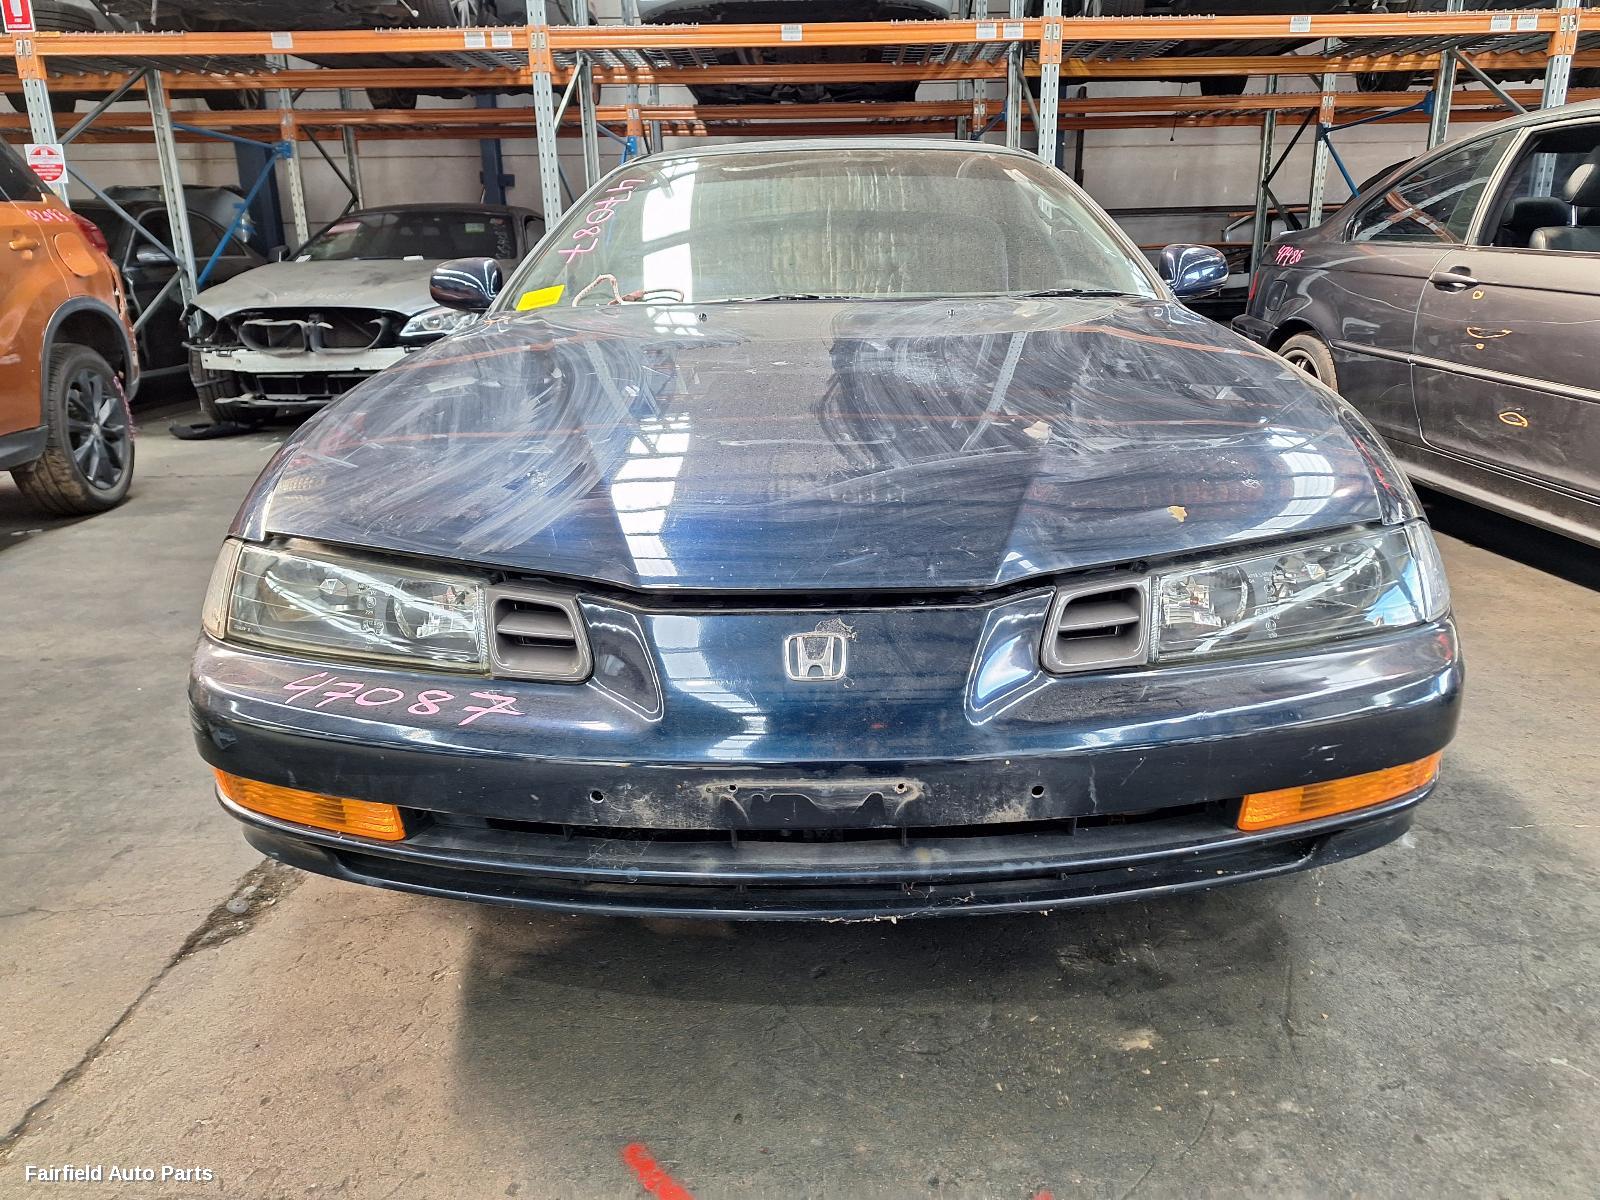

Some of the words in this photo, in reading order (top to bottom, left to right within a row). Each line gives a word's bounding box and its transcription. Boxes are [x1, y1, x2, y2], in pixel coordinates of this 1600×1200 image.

[558, 179, 646, 264] 47087
[1275, 244, 1305, 266] 47486
[283, 671, 526, 726] 47087
